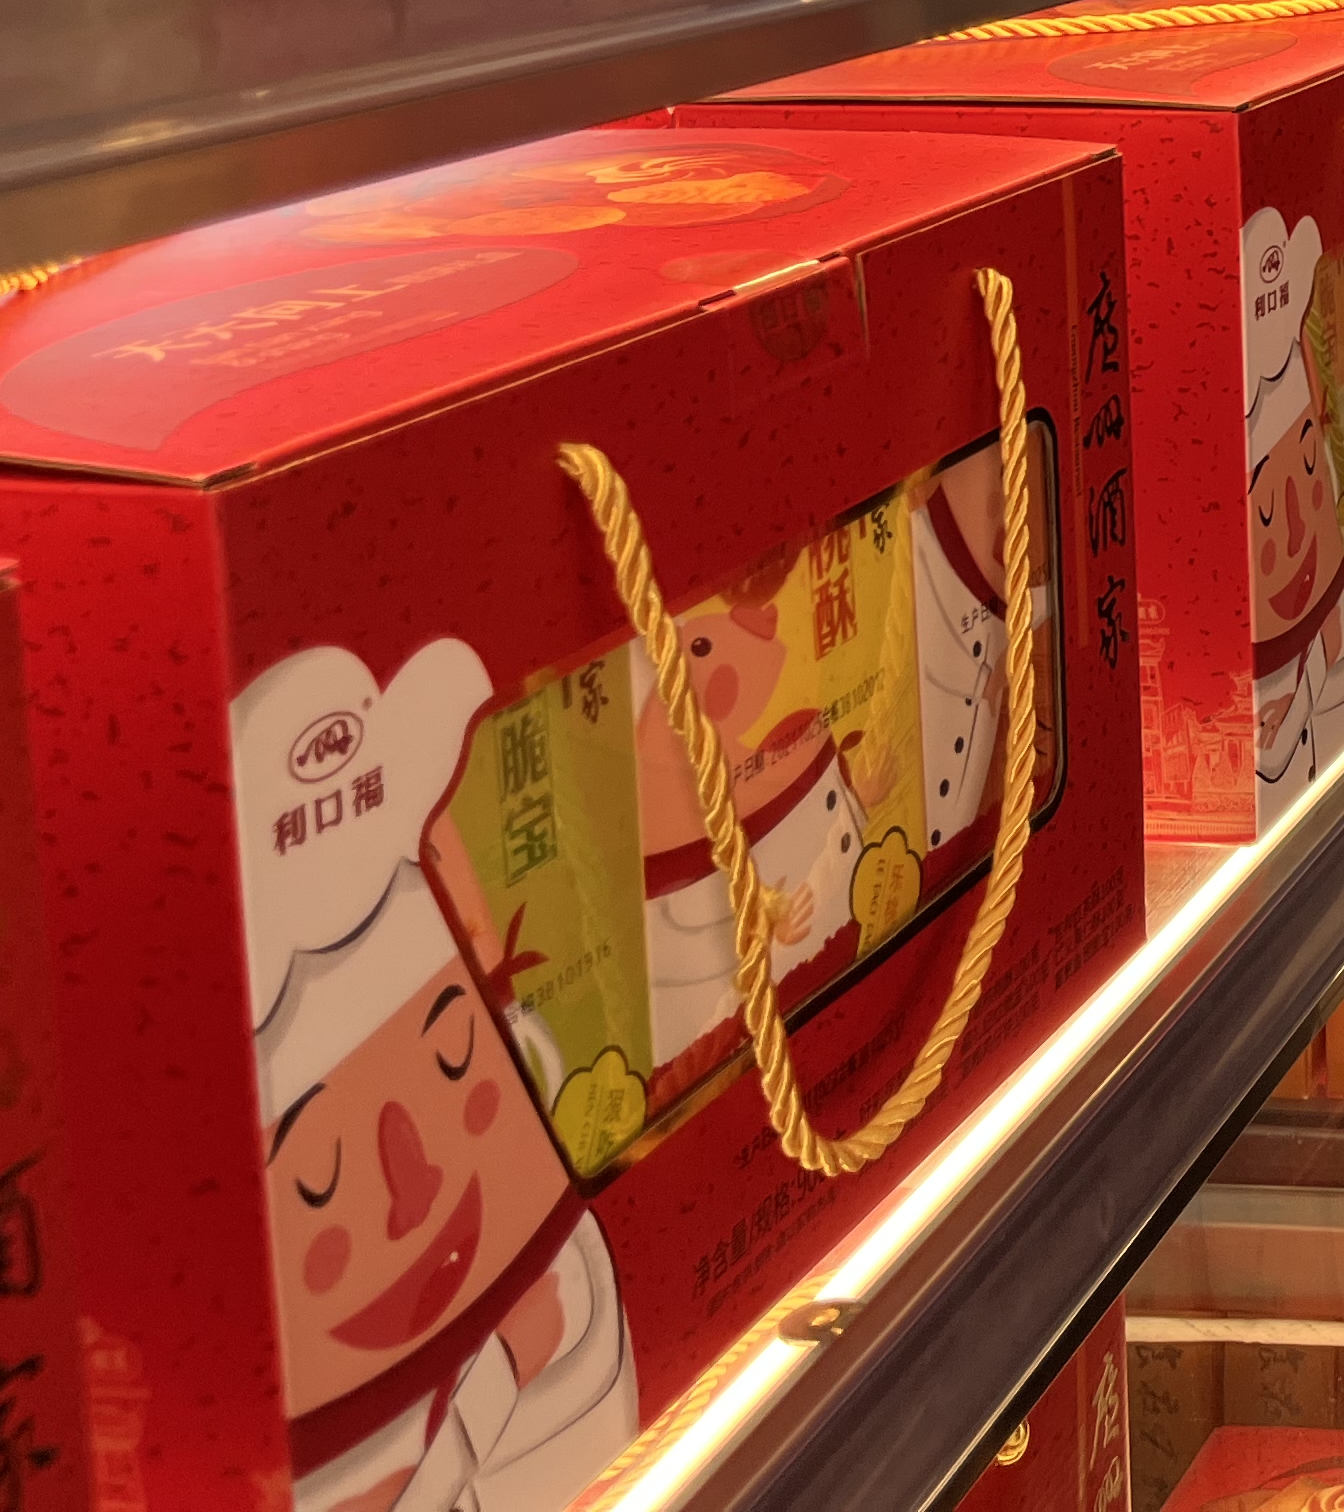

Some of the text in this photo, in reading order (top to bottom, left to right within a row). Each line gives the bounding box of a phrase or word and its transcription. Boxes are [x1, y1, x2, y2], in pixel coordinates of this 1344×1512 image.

[1253, 280, 1291, 322] 利口福
[271, 766, 386, 857] 利口福
